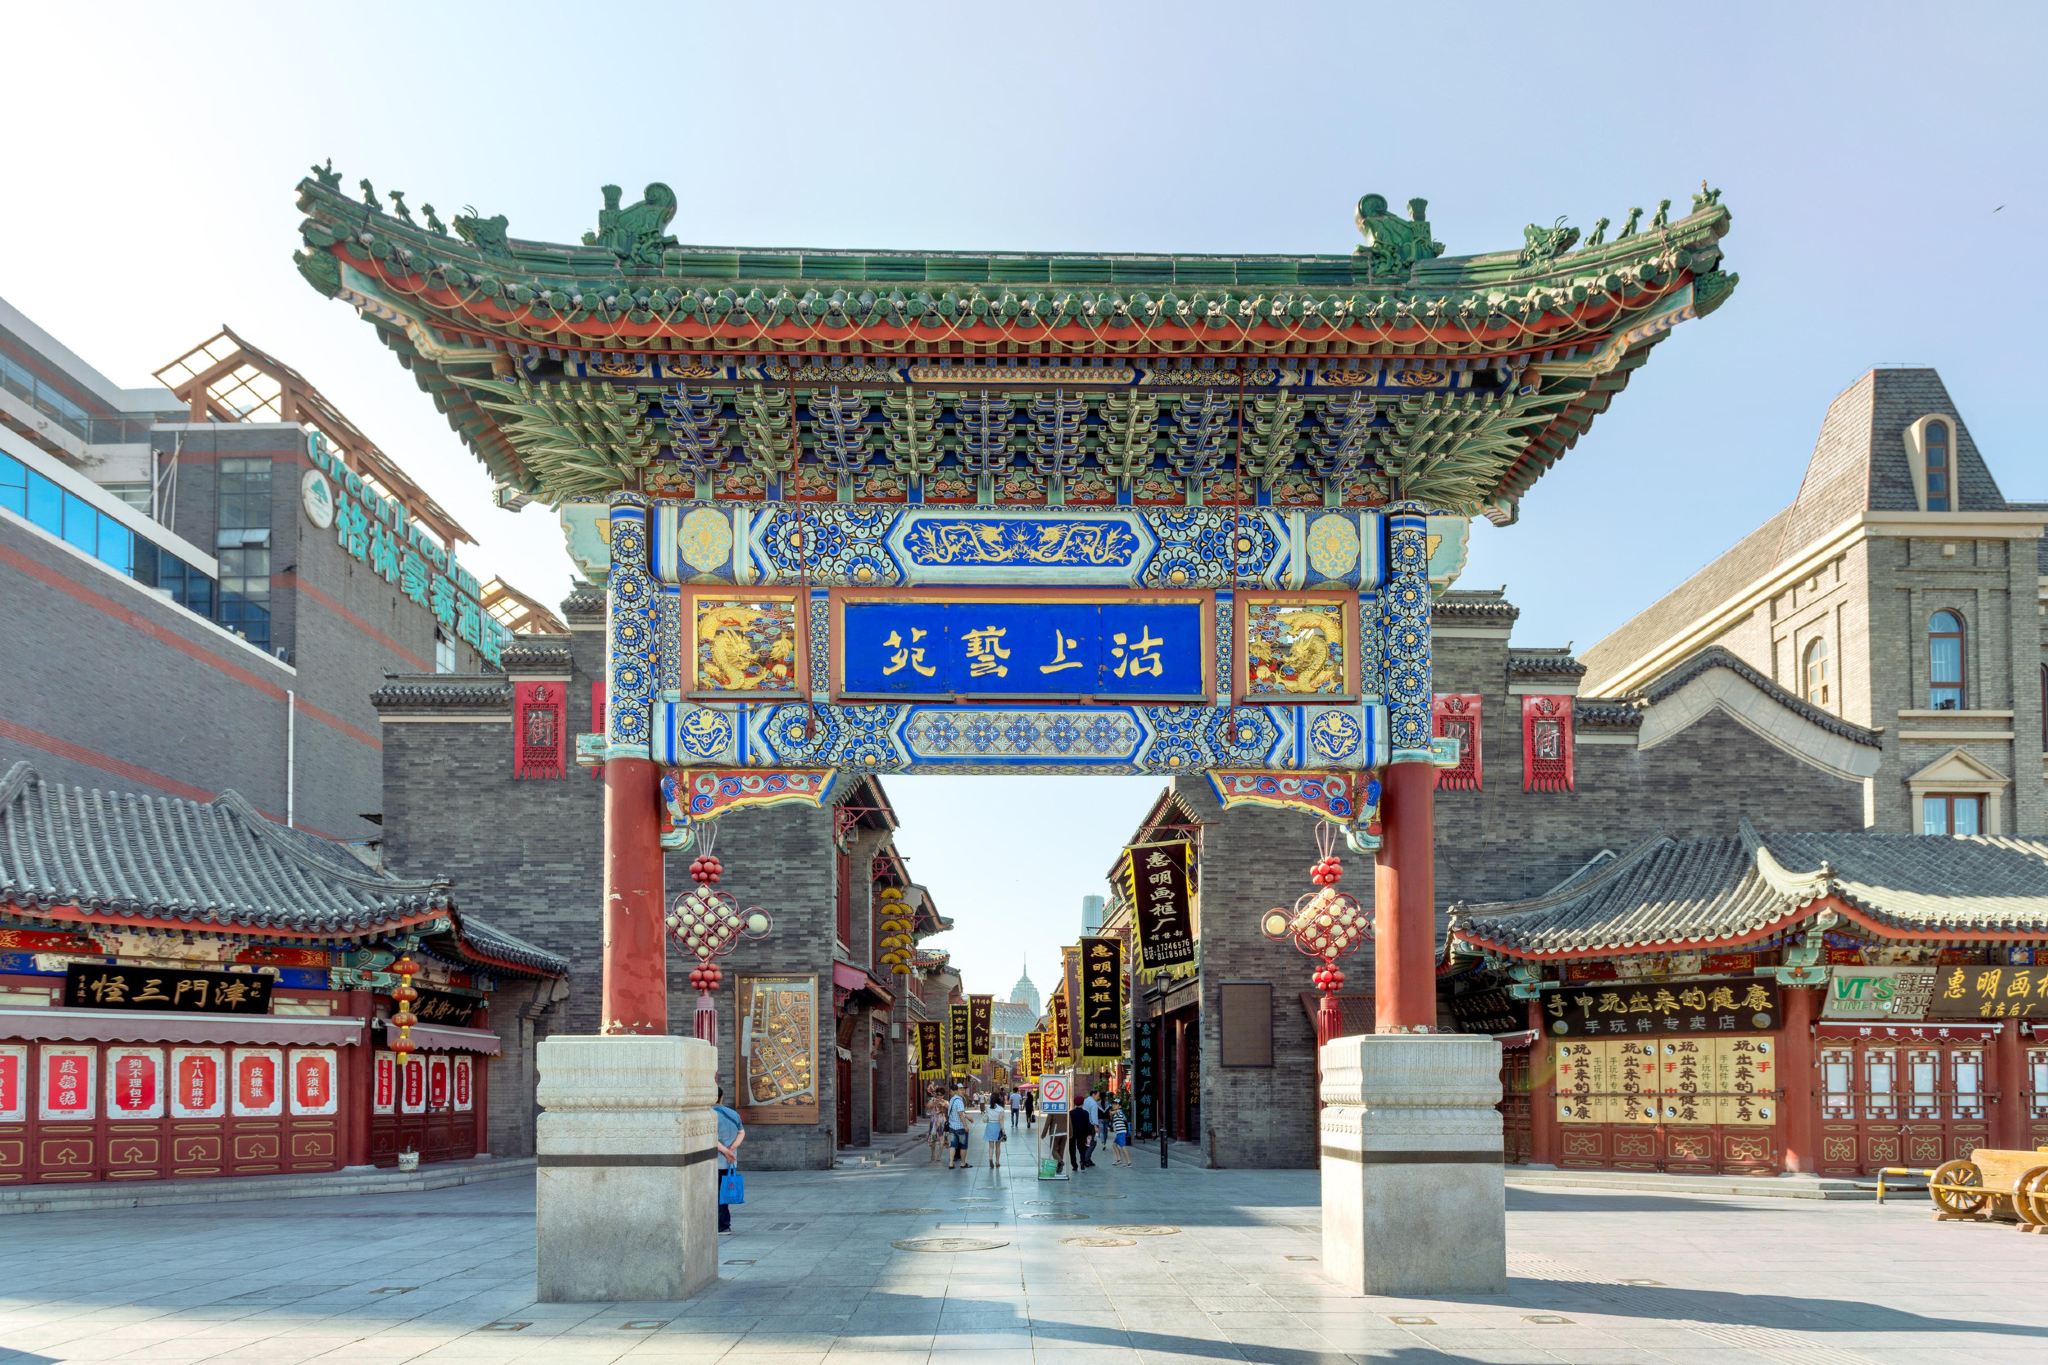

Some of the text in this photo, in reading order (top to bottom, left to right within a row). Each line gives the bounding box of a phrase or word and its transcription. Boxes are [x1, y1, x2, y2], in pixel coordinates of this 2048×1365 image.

[335, 490, 503, 668] 格林豪泰酒店
[883, 625, 1164, 678] 沽上藝苑
[1146, 851, 1177, 932] 惠明画框厂
[1090, 944, 1113, 1019] 惠明画框厂
[1547, 984, 1773, 1018] 手中玩出来的健康
[1834, 977, 1895, 1000] VT'S
[1585, 1015, 1735, 1033] 手玩件专卖店
[1980, 1001, 2036, 1017] 前店后厂
[129, 1059, 142, 1107] 狗不理包子
[192, 1059, 204, 1106] 十八街麻花
[251, 1067, 263, 1097] 皮糖张
[307, 1067, 319, 1097] 龙须酥
[1572, 1043, 1592, 1119] 玩出来的健康
[1609, 1056, 1618, 1106] 手玩件专店
[1621, 1043, 1642, 1120] 玩出来的长寿
[1678, 1041, 1699, 1120] 玩出来的健康
[1733, 1040, 1755, 1121] 玩出来的长寿
